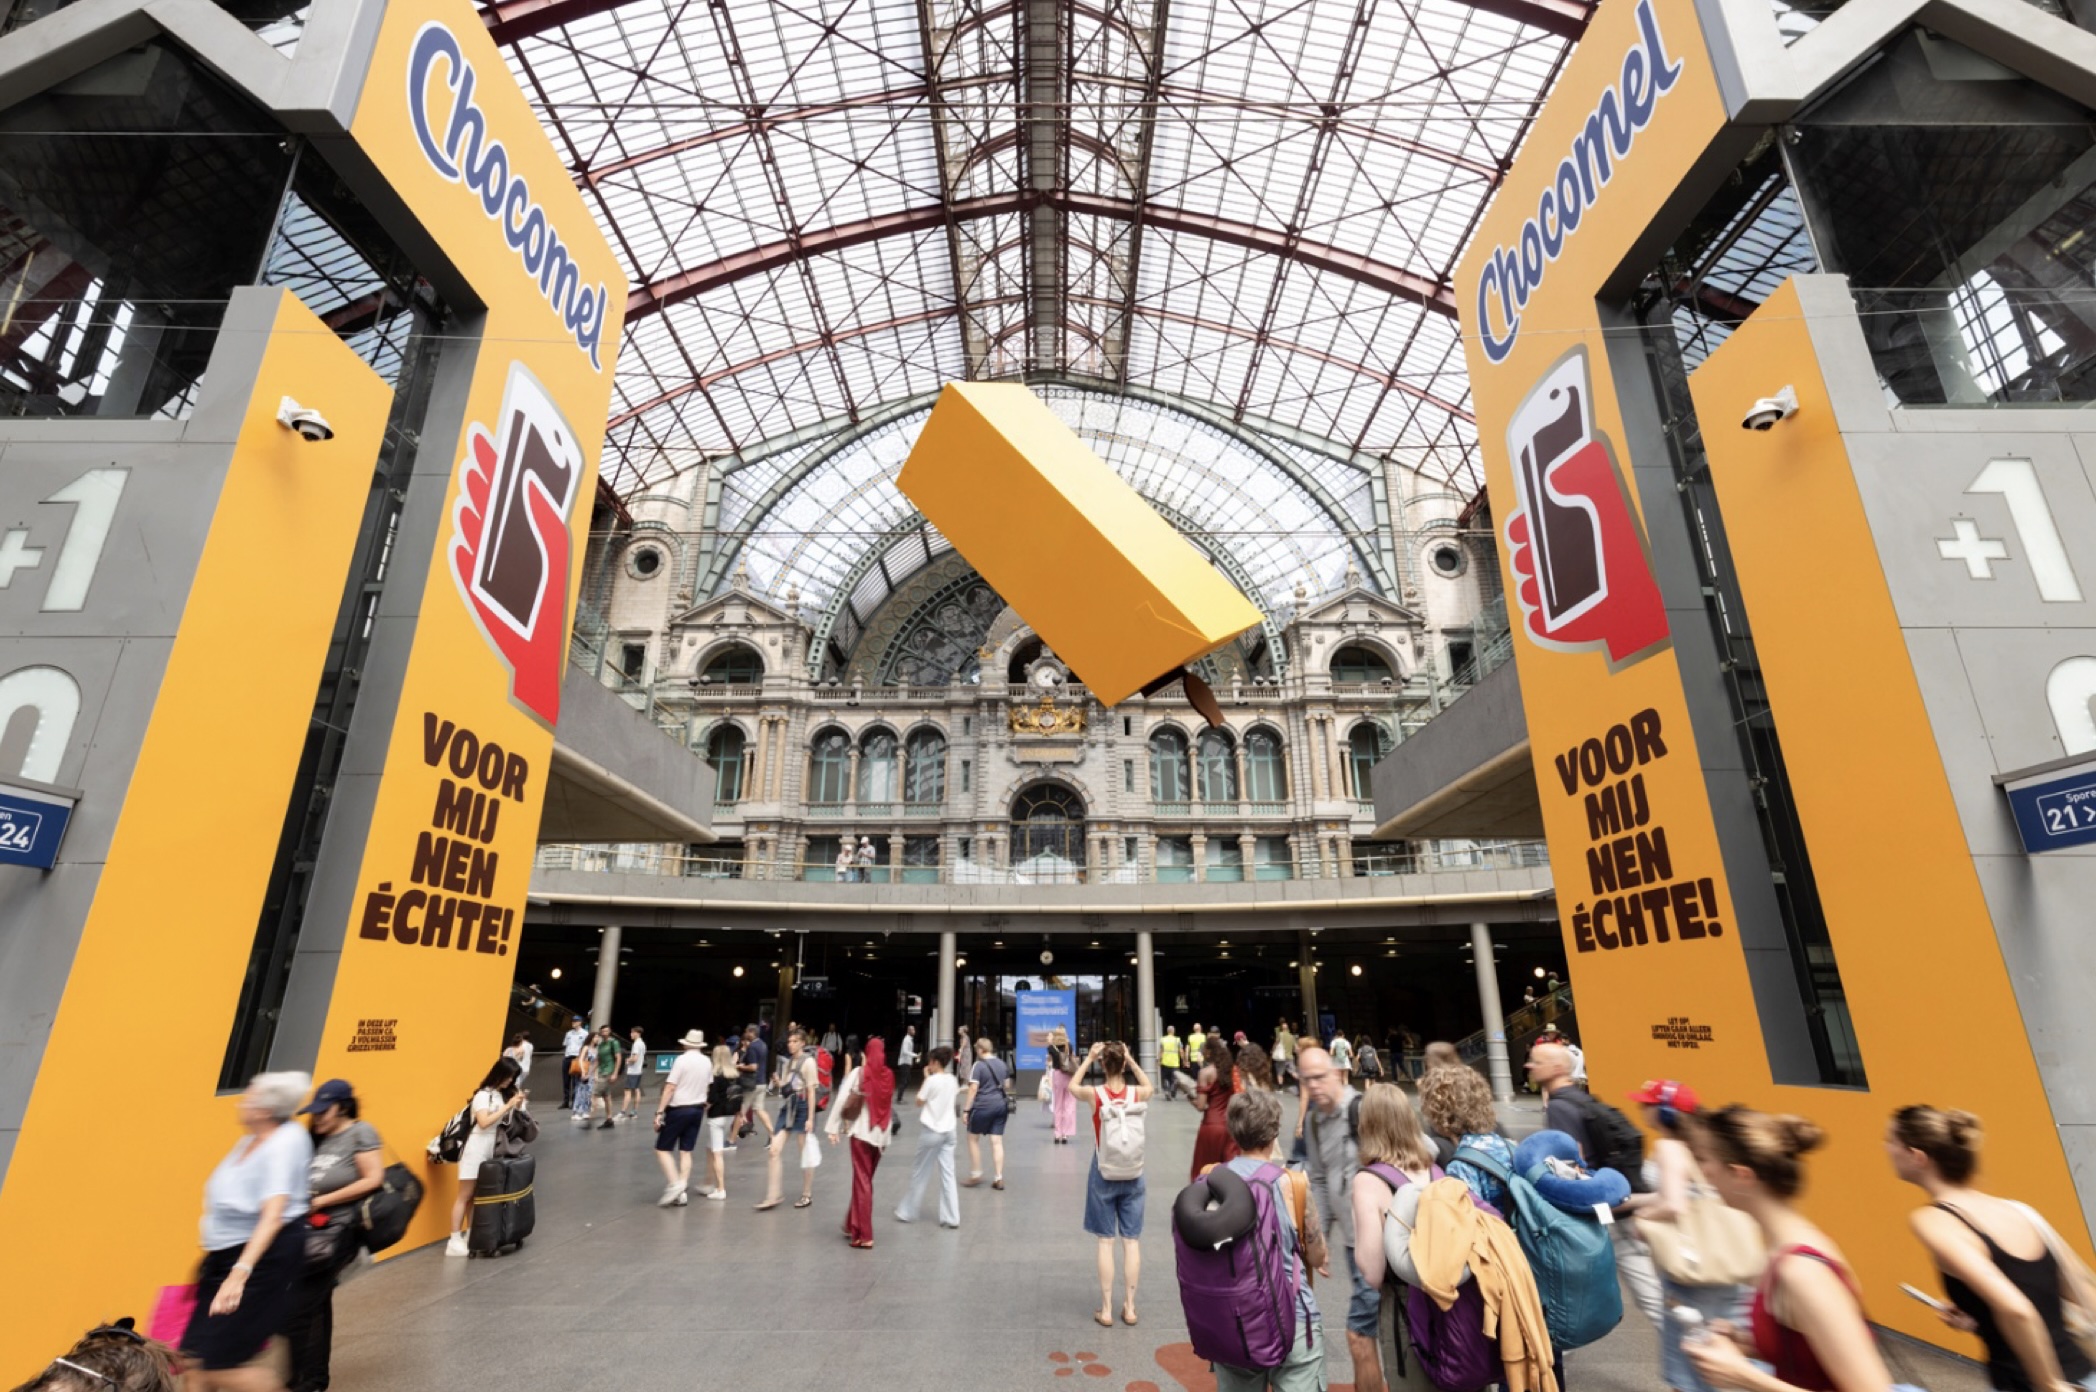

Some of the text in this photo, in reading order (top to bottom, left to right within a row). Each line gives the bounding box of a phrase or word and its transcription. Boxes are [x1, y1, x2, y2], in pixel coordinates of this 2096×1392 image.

[408, 22, 605, 371] Chocomel
[1477, 0, 1682, 363] Chocomel
[1934, 457, 2086, 603] +1
[425, 712, 528, 802] VOOR
[1555, 709, 1667, 795] VOOR
[0, 822, 31, 848] 24
[433, 779, 500, 844] MIJ
[1585, 774, 1650, 840] MIJ
[2047, 804, 2078, 831] 21
[411, 832, 498, 899] NEN
[1587, 827, 1673, 895] NEN
[360, 883, 514, 956] ÉCHTE!
[1572, 878, 1722, 953] ÉCHTE!
